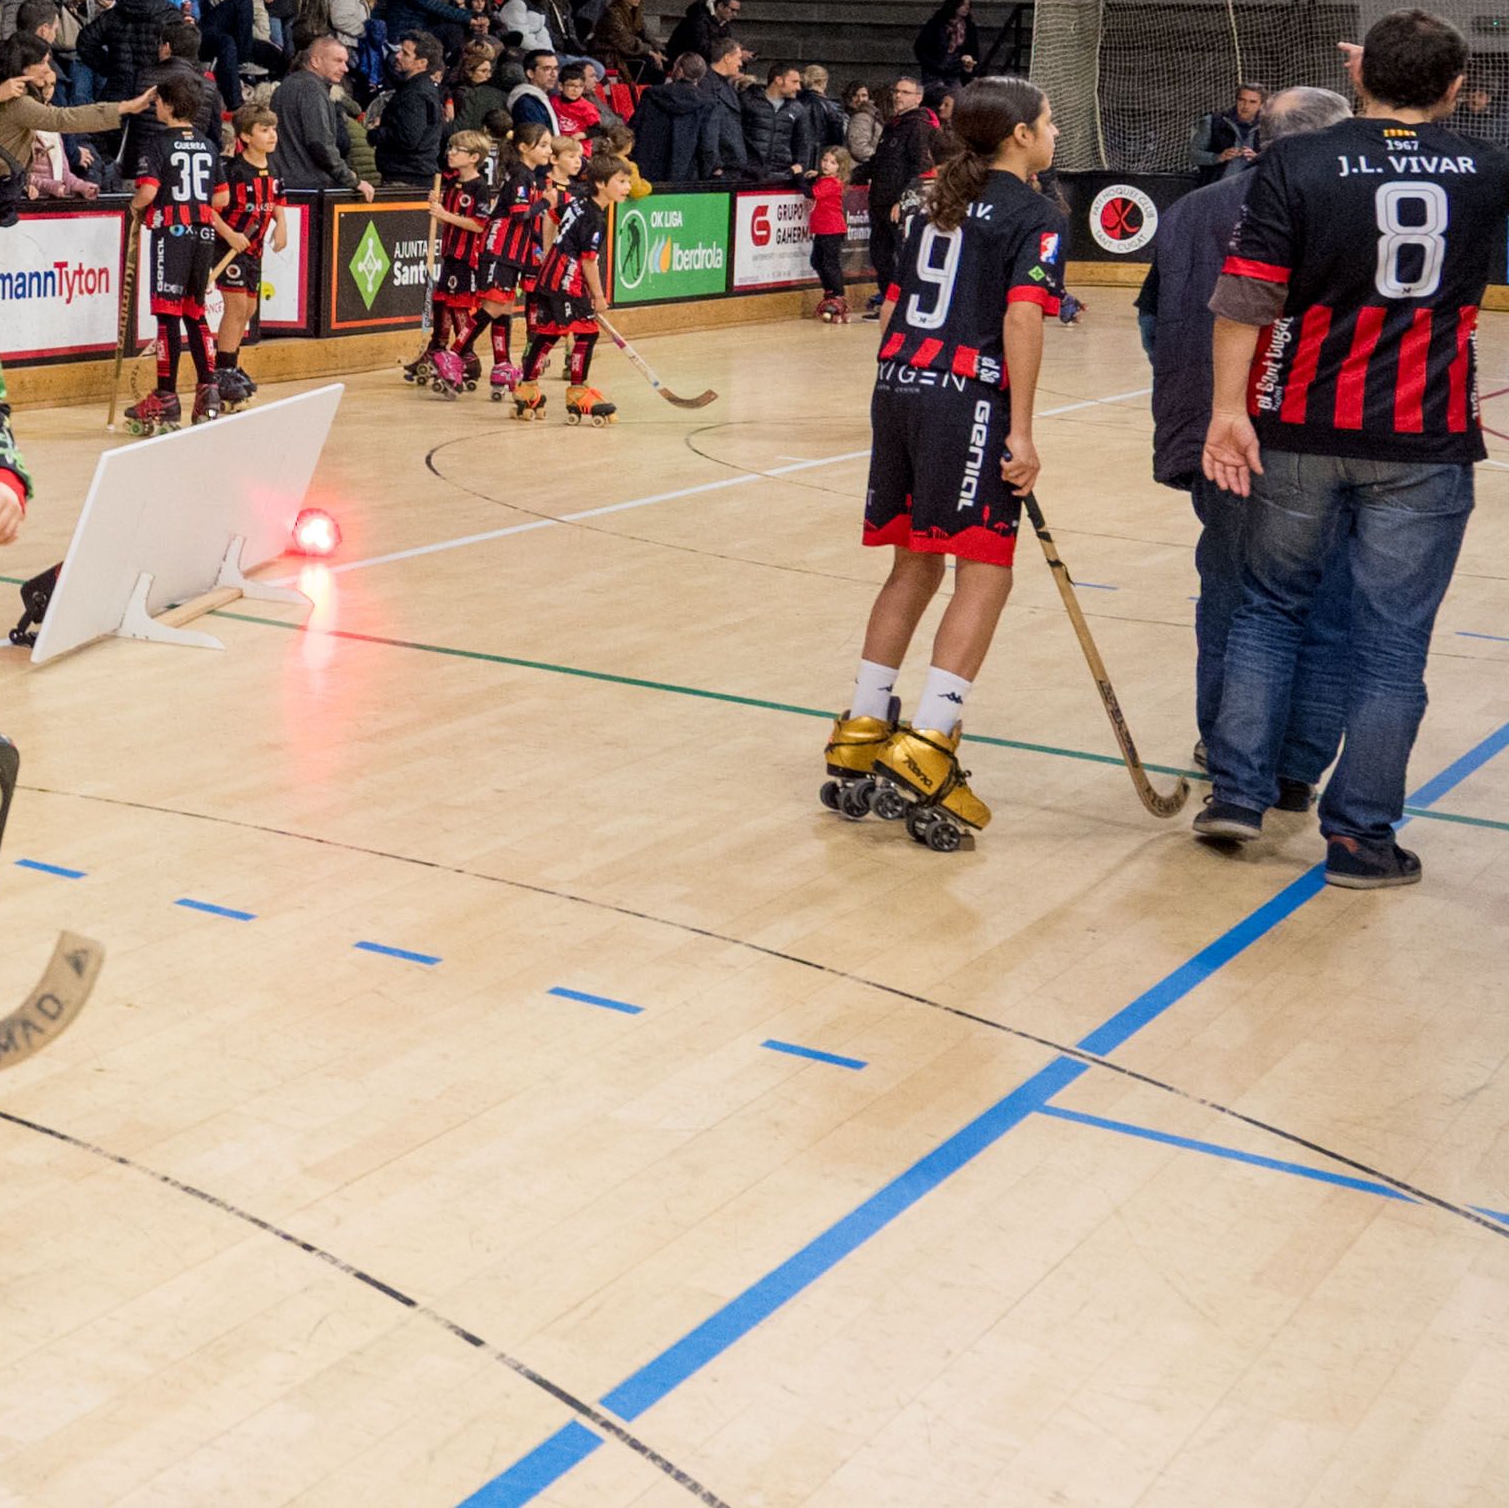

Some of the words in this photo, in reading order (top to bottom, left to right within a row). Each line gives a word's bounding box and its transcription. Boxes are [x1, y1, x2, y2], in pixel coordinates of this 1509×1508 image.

[1385, 139, 1420, 151] 1967
[1338, 155, 1383, 177] J.L.
[1388, 155, 1477, 174] VIVAR
[651, 211, 664, 228] OK
[664, 210, 683, 227] LIGA
[777, 204, 803, 221] GRUPO
[1374, 180, 1449, 299] 8
[672, 240, 723, 271] Iberdrola
[906, 224, 963, 330] 9
